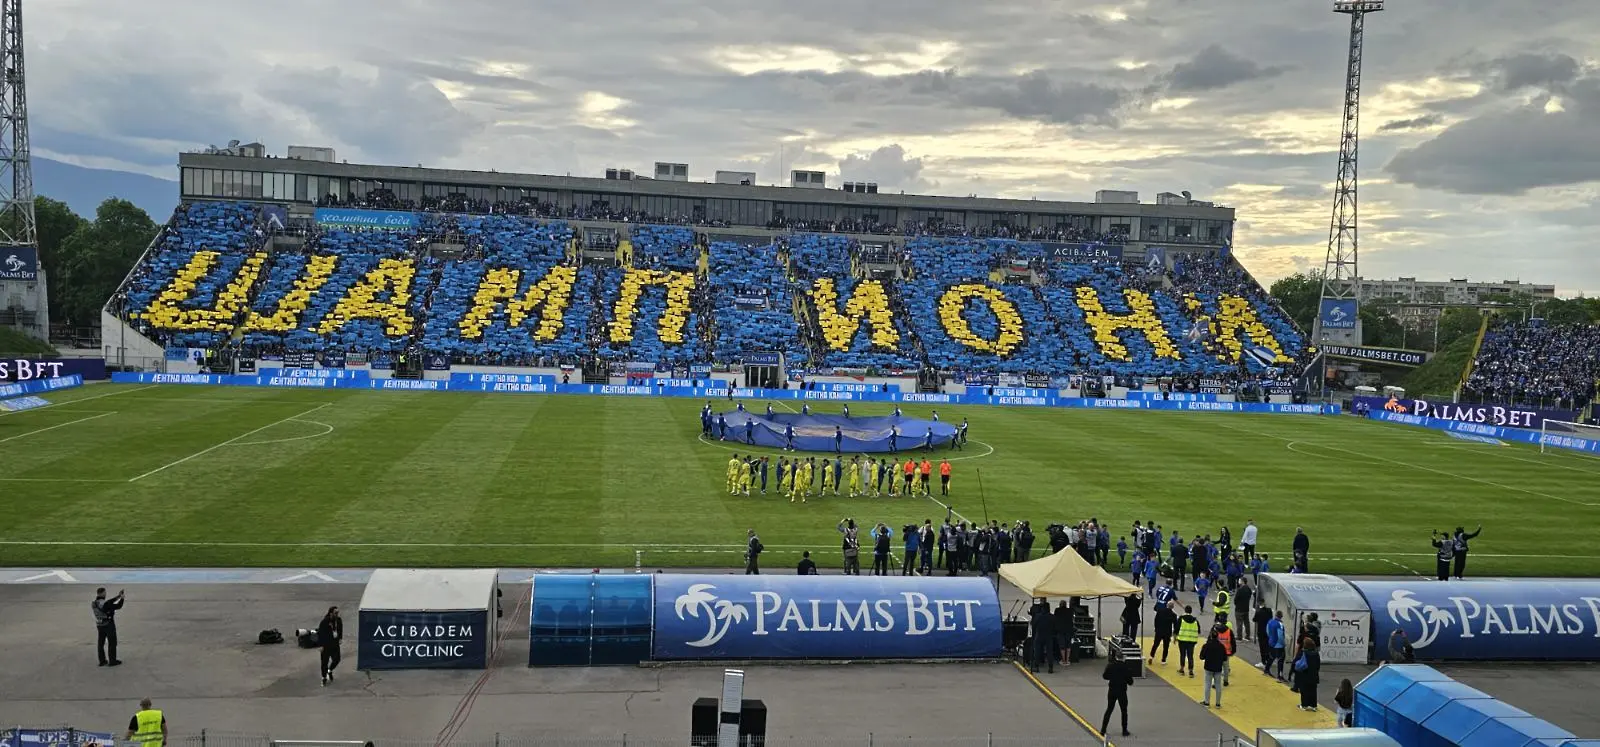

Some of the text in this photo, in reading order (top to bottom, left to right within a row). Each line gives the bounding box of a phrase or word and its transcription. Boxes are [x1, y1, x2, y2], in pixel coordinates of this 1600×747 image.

[1054, 248, 1109, 257] ACIBEM
[1342, 320, 1354, 328] BET
[1322, 345, 1420, 363] WWW.PALMSBET.COM
[1413, 400, 1487, 424] PALMS
[1493, 406, 1536, 427] BET
[750, 591, 981, 636] PALMS BET
[1447, 596, 1585, 638] PALMS
[373, 625, 473, 637] ACIBADEM
[1323, 635, 1365, 645] BADEM
[381, 643, 464, 658] CITYCLINIC
